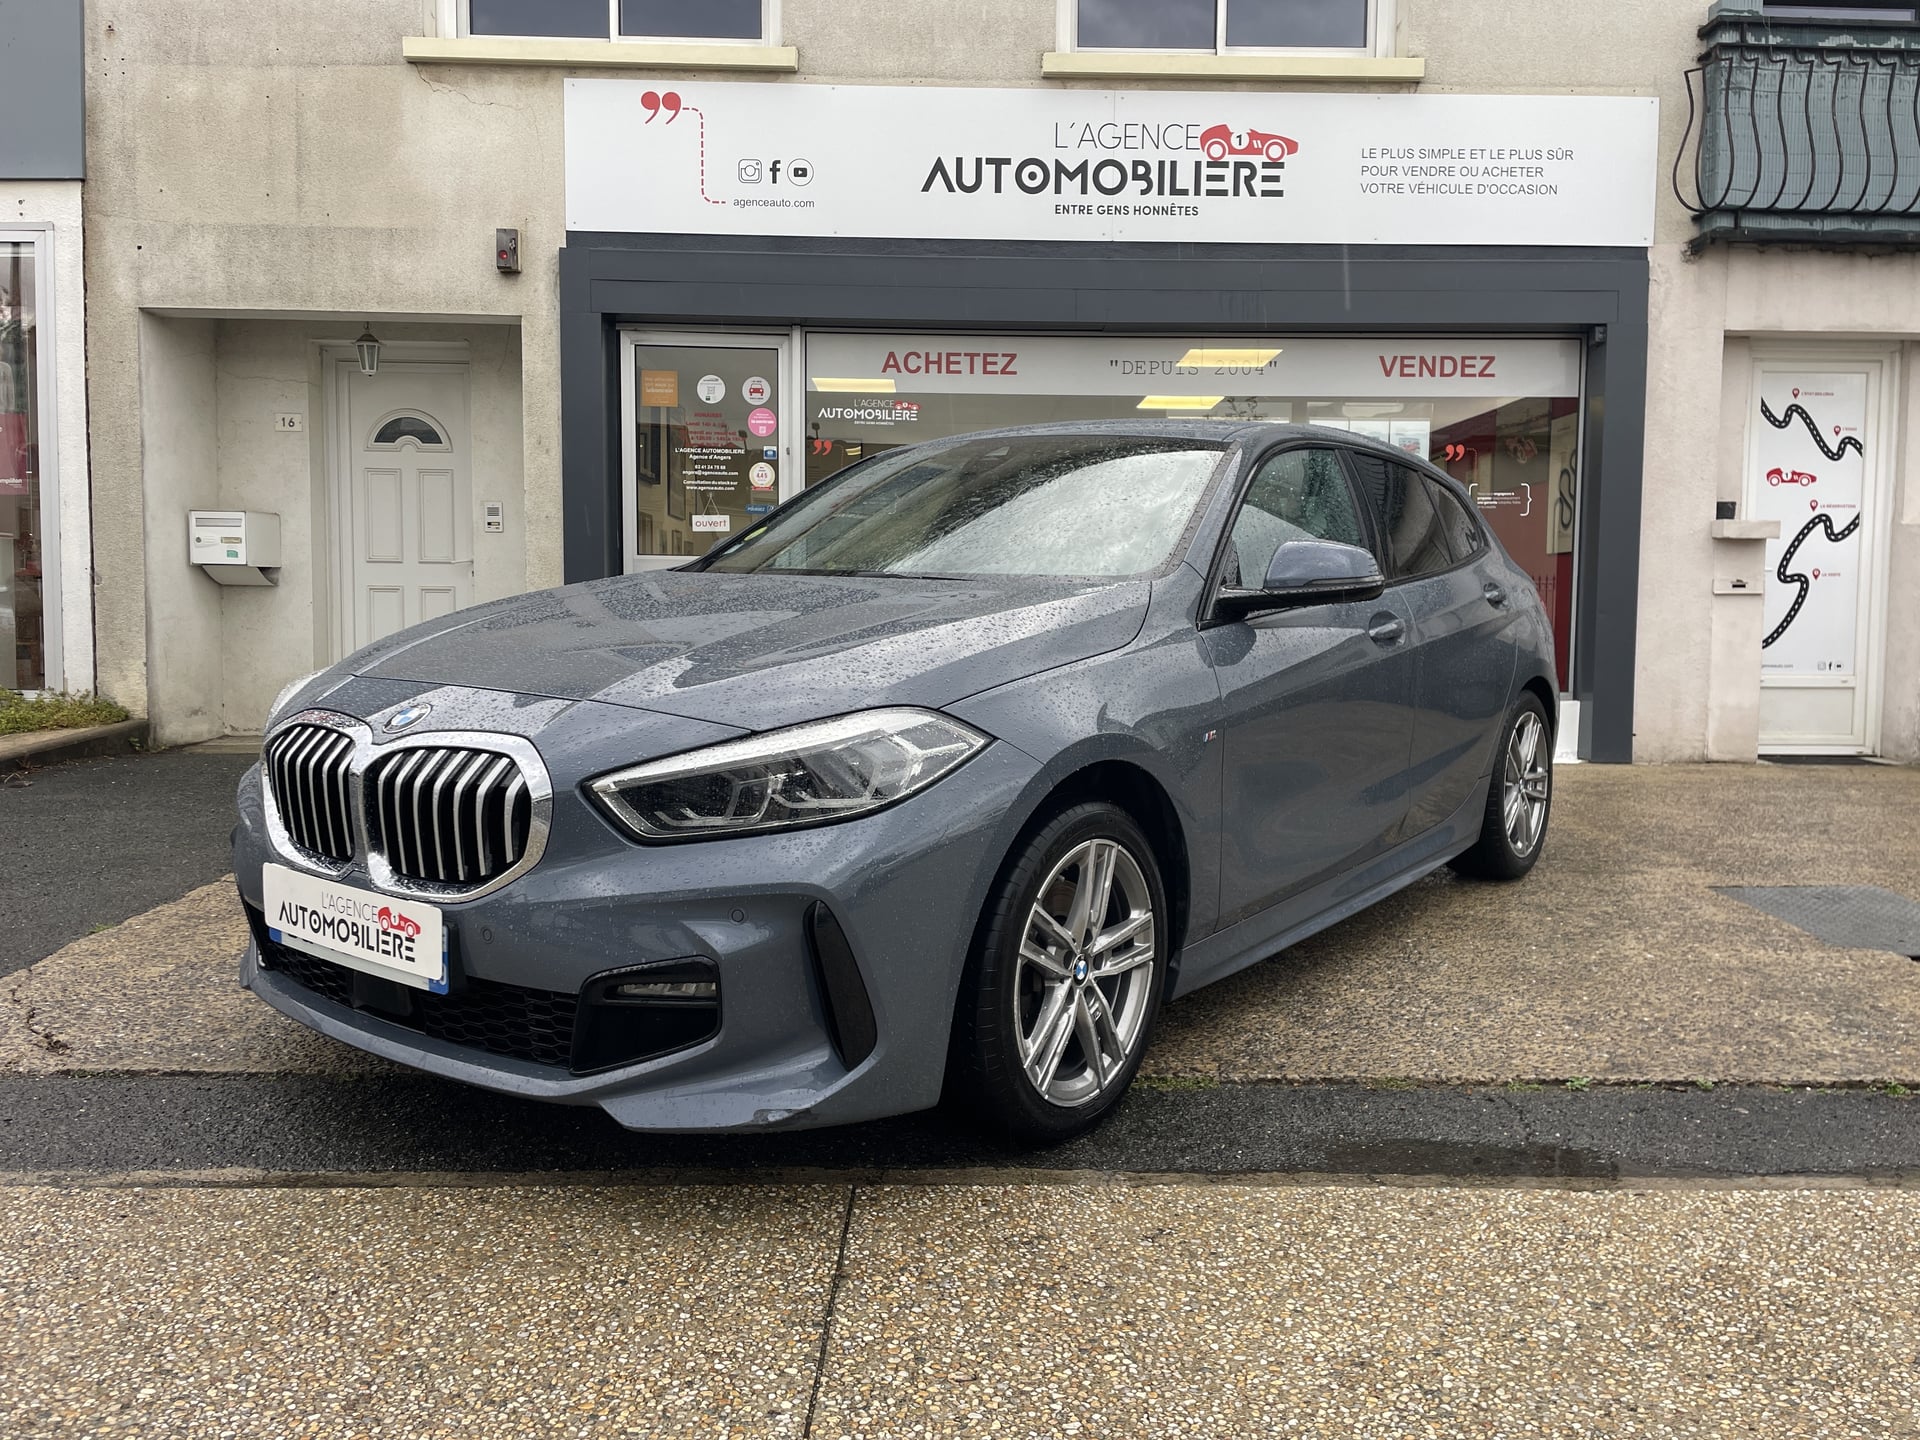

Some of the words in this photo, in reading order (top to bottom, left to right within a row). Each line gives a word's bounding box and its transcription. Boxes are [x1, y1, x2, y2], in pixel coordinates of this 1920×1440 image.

[1055, 122, 1200, 150] L'AGENCE
[1361, 148, 1377, 159] LE
[1381, 148, 1415, 159] PLUS
[1418, 148, 1466, 160] SIMPLE
[1470, 149, 1487, 160] ET
[1490, 149, 1505, 160] LE
[1509, 149, 1543, 160] PLUS
[1546, 147, 1574, 161] SÛR
[1361, 165, 1398, 177] POUR
[1402, 166, 1456, 177] VENDRE
[1460, 166, 1479, 177] OU
[1482, 166, 1544, 178] ACHETER
[1360, 183, 1405, 194] VOTRE
[1408, 181, 1473, 195] VÉHICULE
[1477, 184, 1558, 195] D'OCCASION
[733, 198, 815, 209] agenceauto.com
[1055, 204, 1095, 216] ENTRE
[1097, 205, 1130, 216] GENS
[1133, 203, 1199, 216] HONNÊTES
[881, 351, 1018, 375] ACHETEZ
[1379, 355, 1496, 378] VENDEZ
[854, 398, 894, 408] L'AGENCE
[281, 417, 295, 427] 16
[695, 518, 727, 528] ouvert
[321, 891, 379, 923] L'AGENCE
